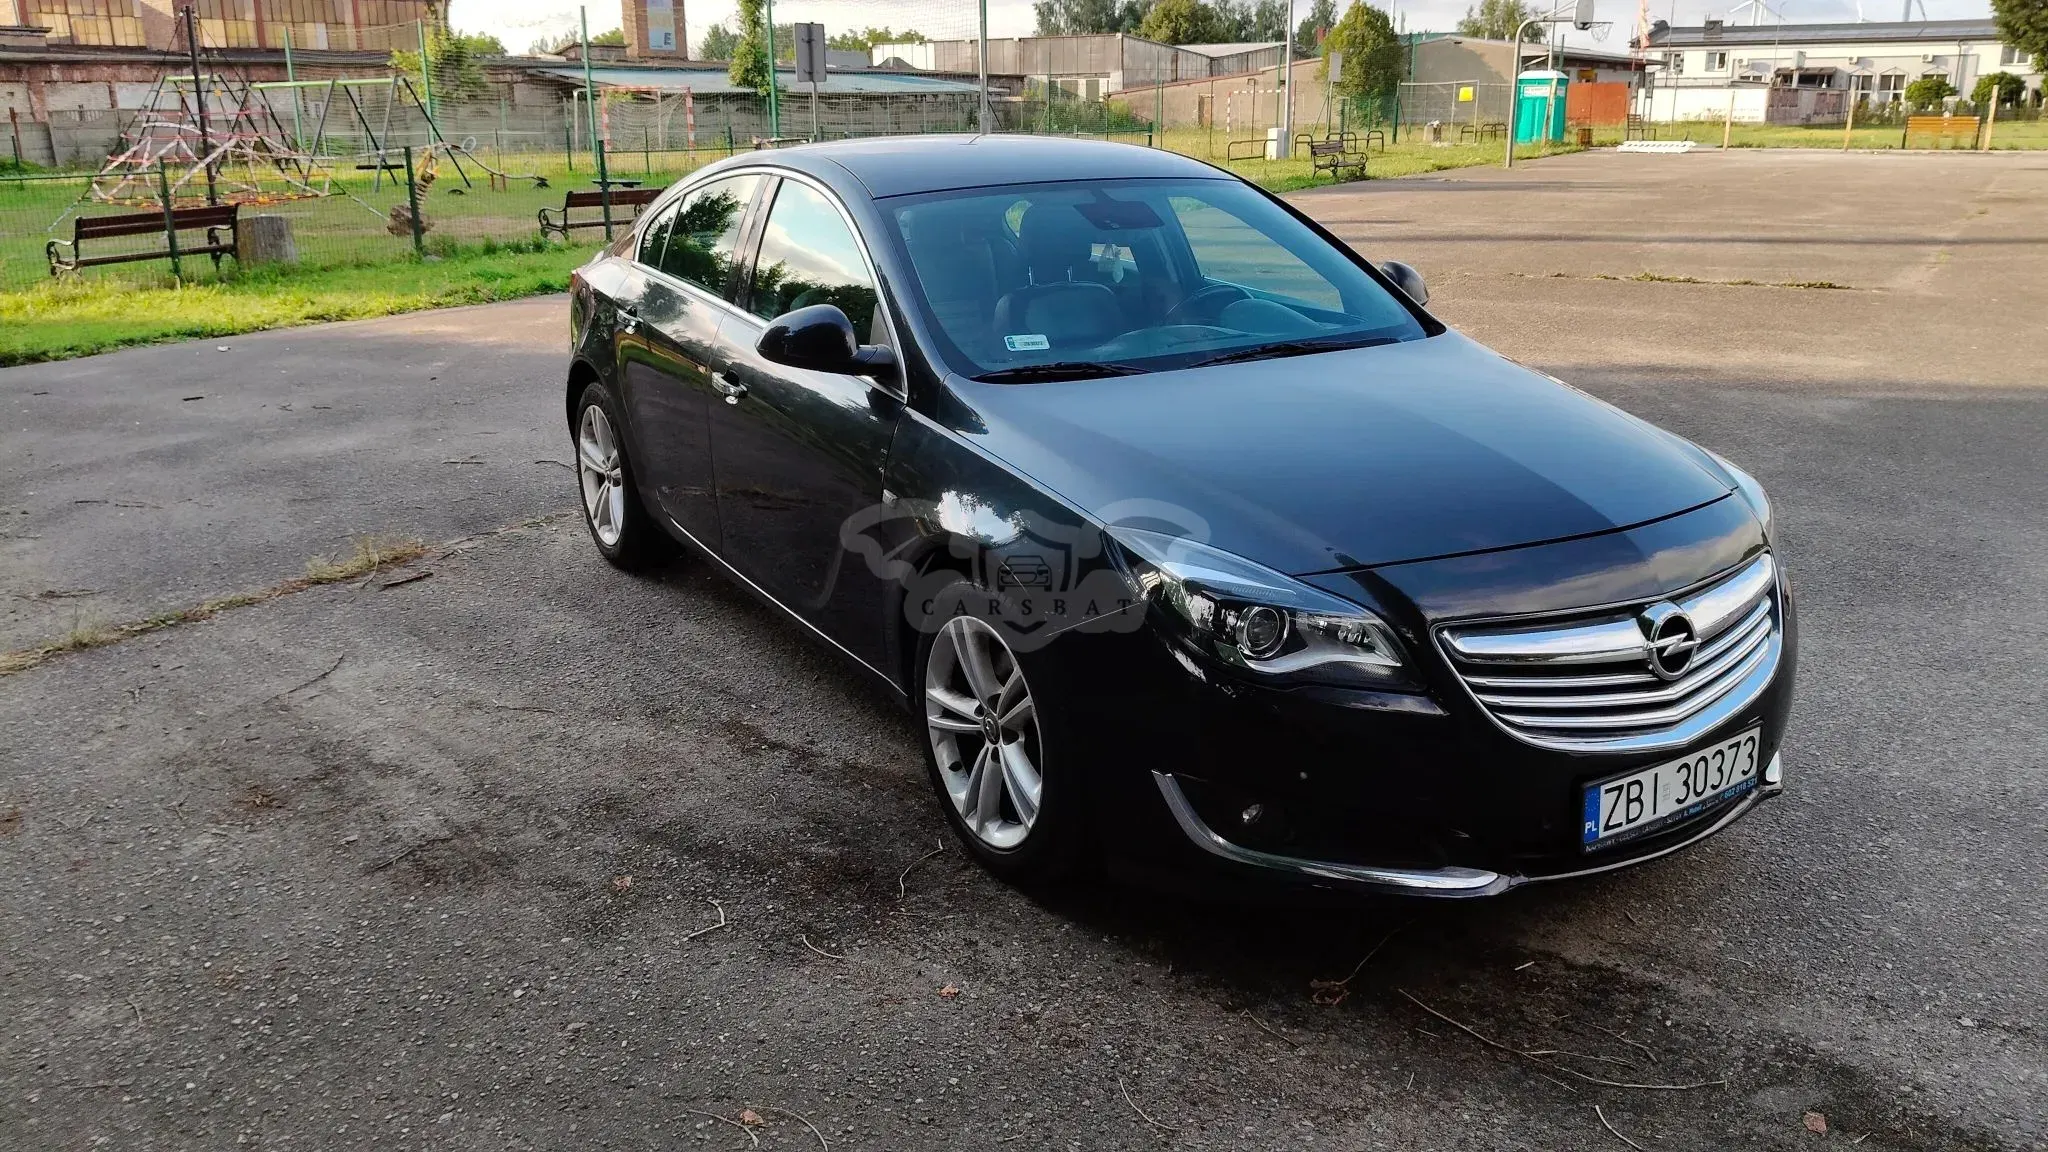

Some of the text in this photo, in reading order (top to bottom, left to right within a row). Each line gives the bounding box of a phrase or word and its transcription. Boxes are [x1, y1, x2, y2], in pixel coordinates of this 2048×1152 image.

[1603, 772, 1659, 833] ZBI
[1675, 735, 1757, 805] 30373
[1584, 820, 1598, 835] PL
